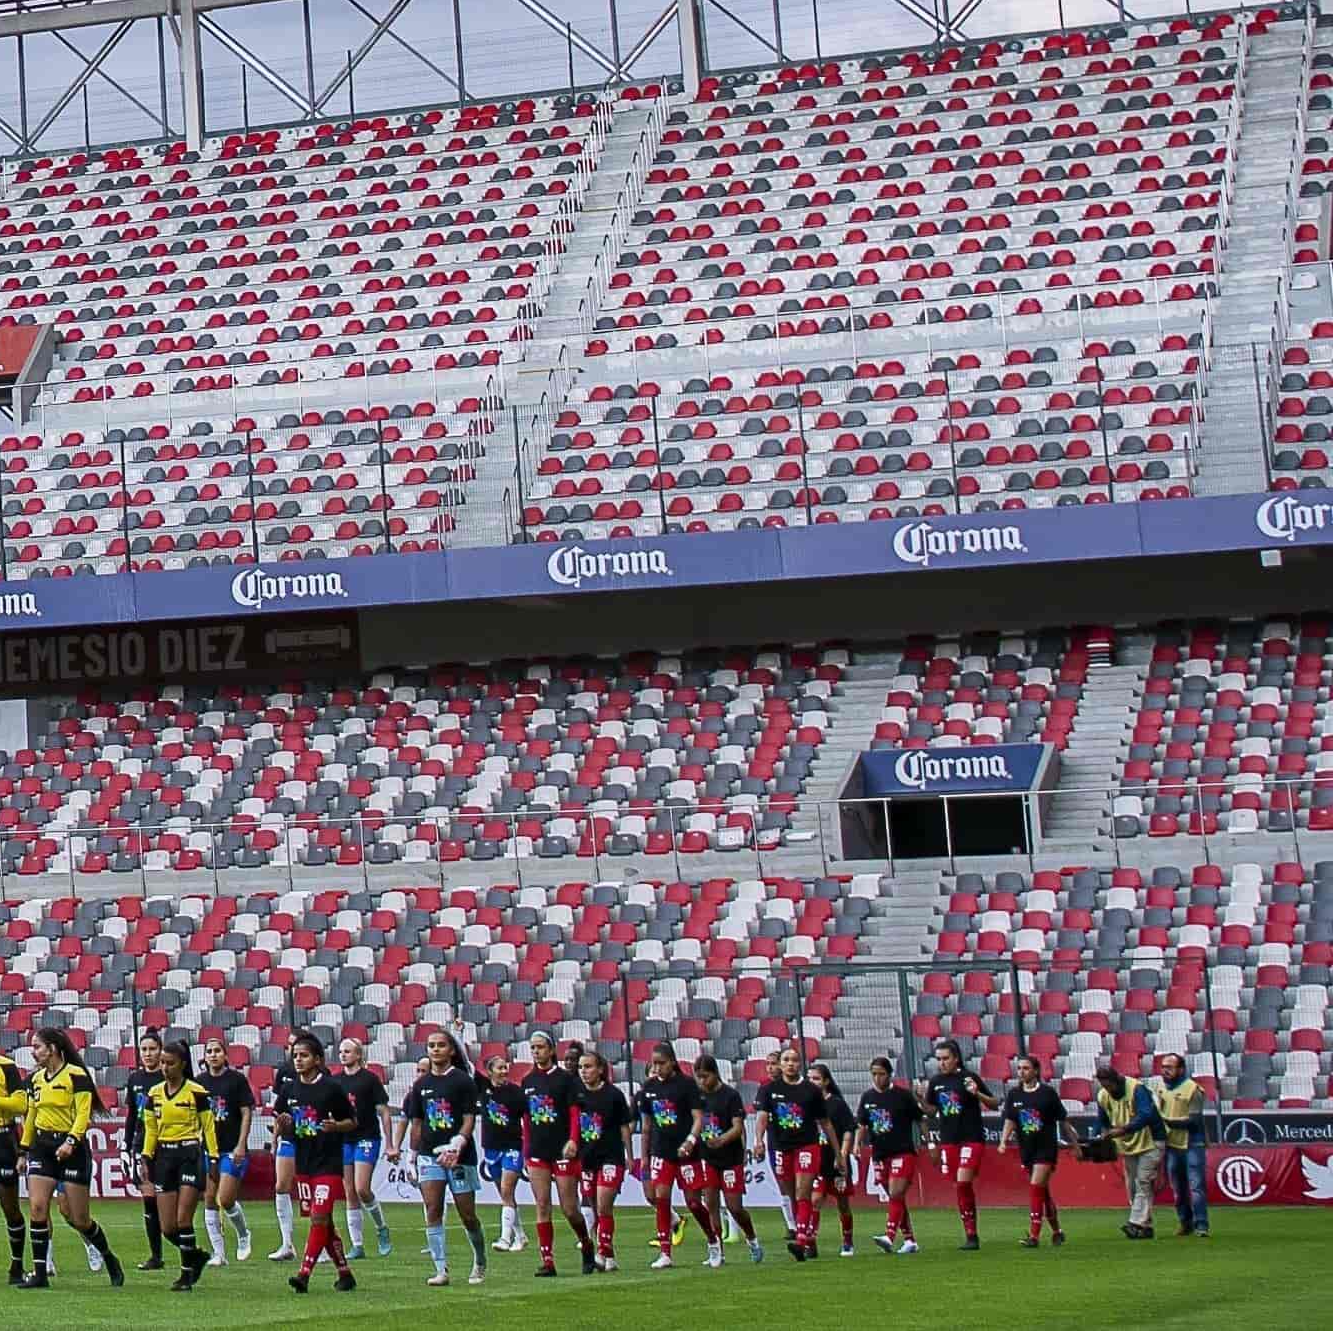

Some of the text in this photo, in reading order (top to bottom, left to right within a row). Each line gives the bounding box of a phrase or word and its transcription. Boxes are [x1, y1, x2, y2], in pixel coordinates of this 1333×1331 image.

[893, 521, 1028, 566] Corona
[547, 546, 673, 588] Corona
[233, 569, 349, 609] Corona
[158, 625, 246, 673] DIEZ
[895, 750, 1013, 790] Corona
